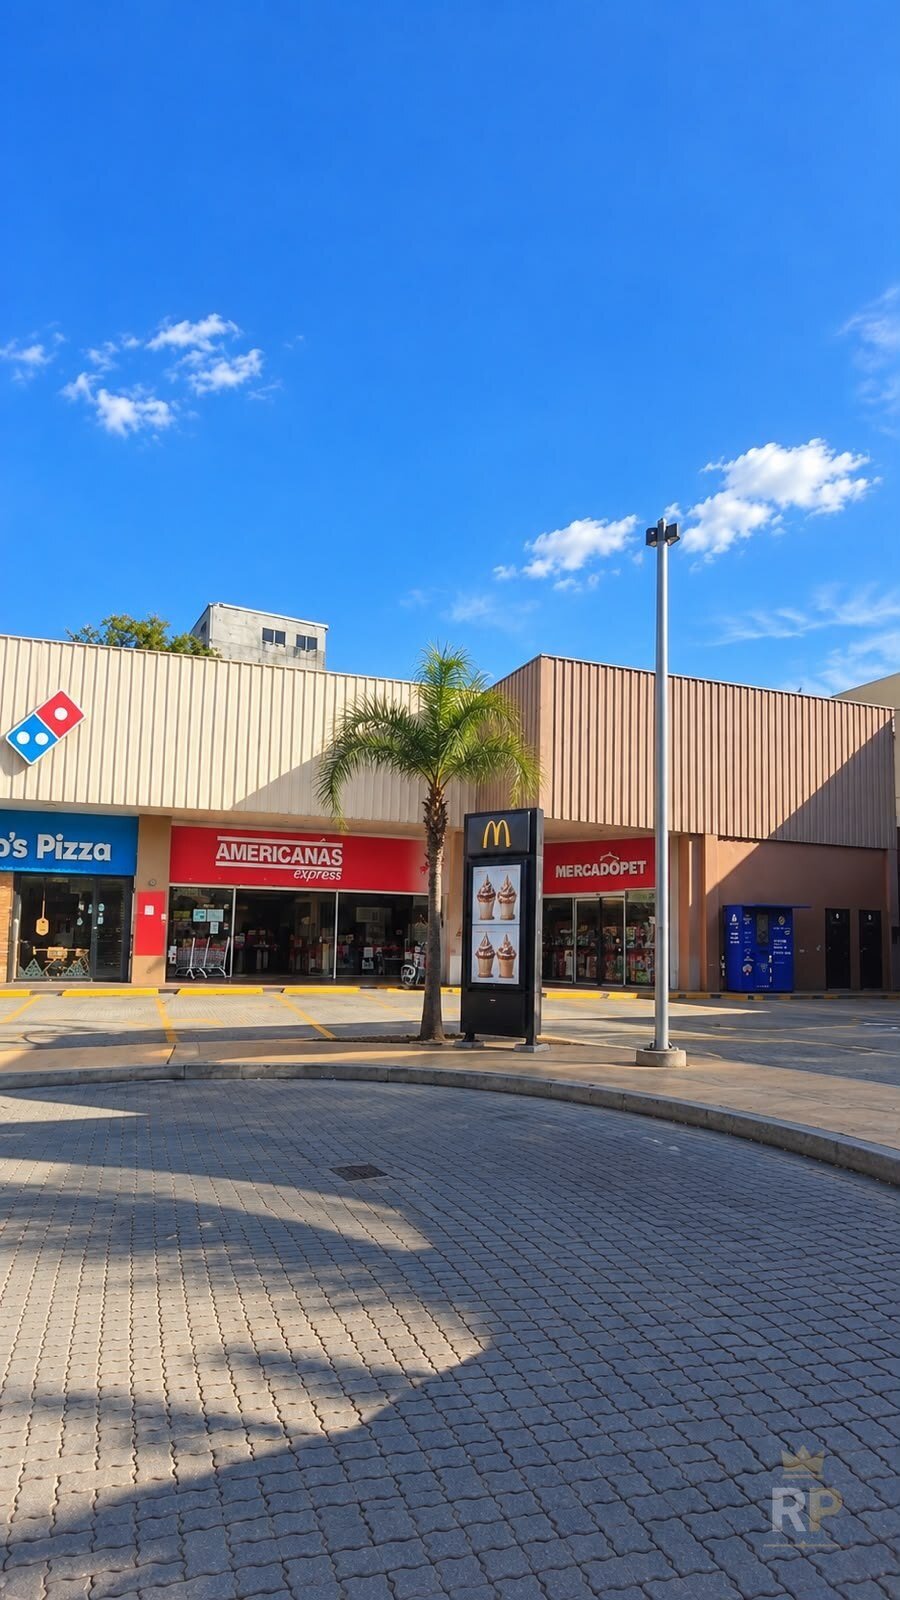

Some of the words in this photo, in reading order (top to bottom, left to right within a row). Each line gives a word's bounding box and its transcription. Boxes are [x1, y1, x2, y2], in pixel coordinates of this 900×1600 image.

[36, 833, 112, 862] Pizza
[215, 842, 343, 867] AMERICANAS
[293, 869, 342, 883] express
